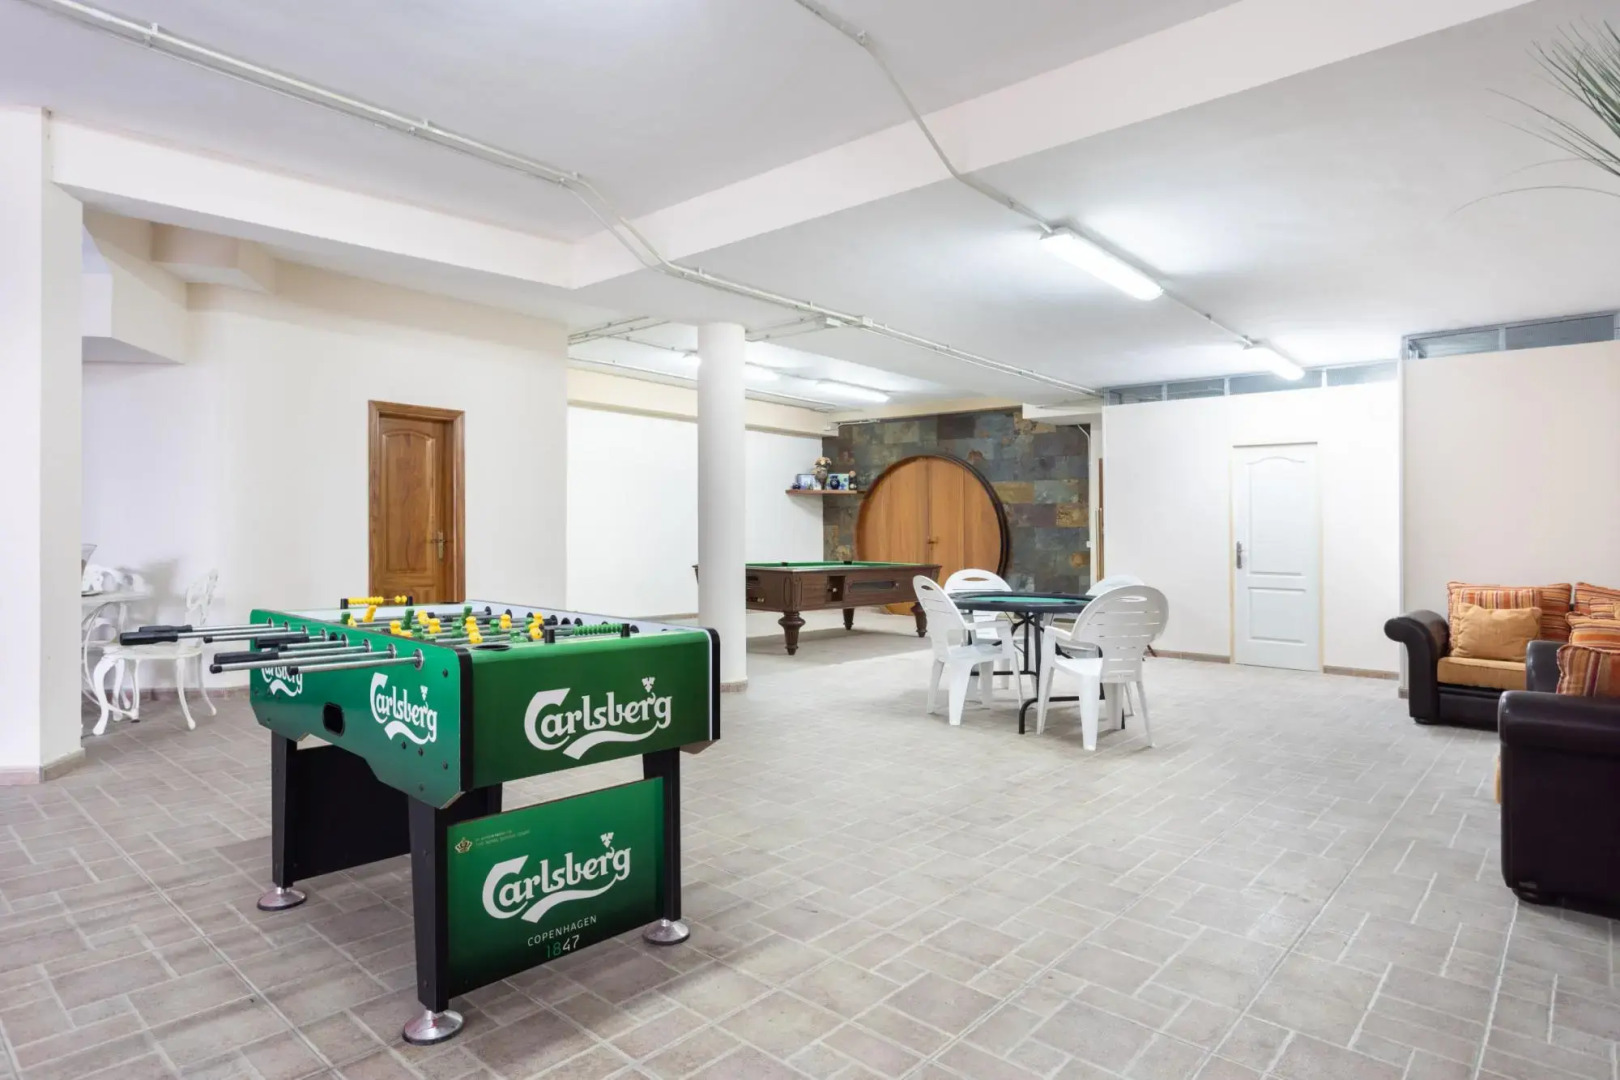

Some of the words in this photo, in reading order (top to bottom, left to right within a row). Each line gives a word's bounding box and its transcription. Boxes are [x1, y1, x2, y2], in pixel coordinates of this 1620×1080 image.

[370, 672, 437, 745] Carlsberg
[524, 685, 673, 760] Carlsberg
[482, 845, 631, 924] Carlsberg
[527, 914, 597, 947] COPENHAGEN
[546, 934, 580, 959] 1847
